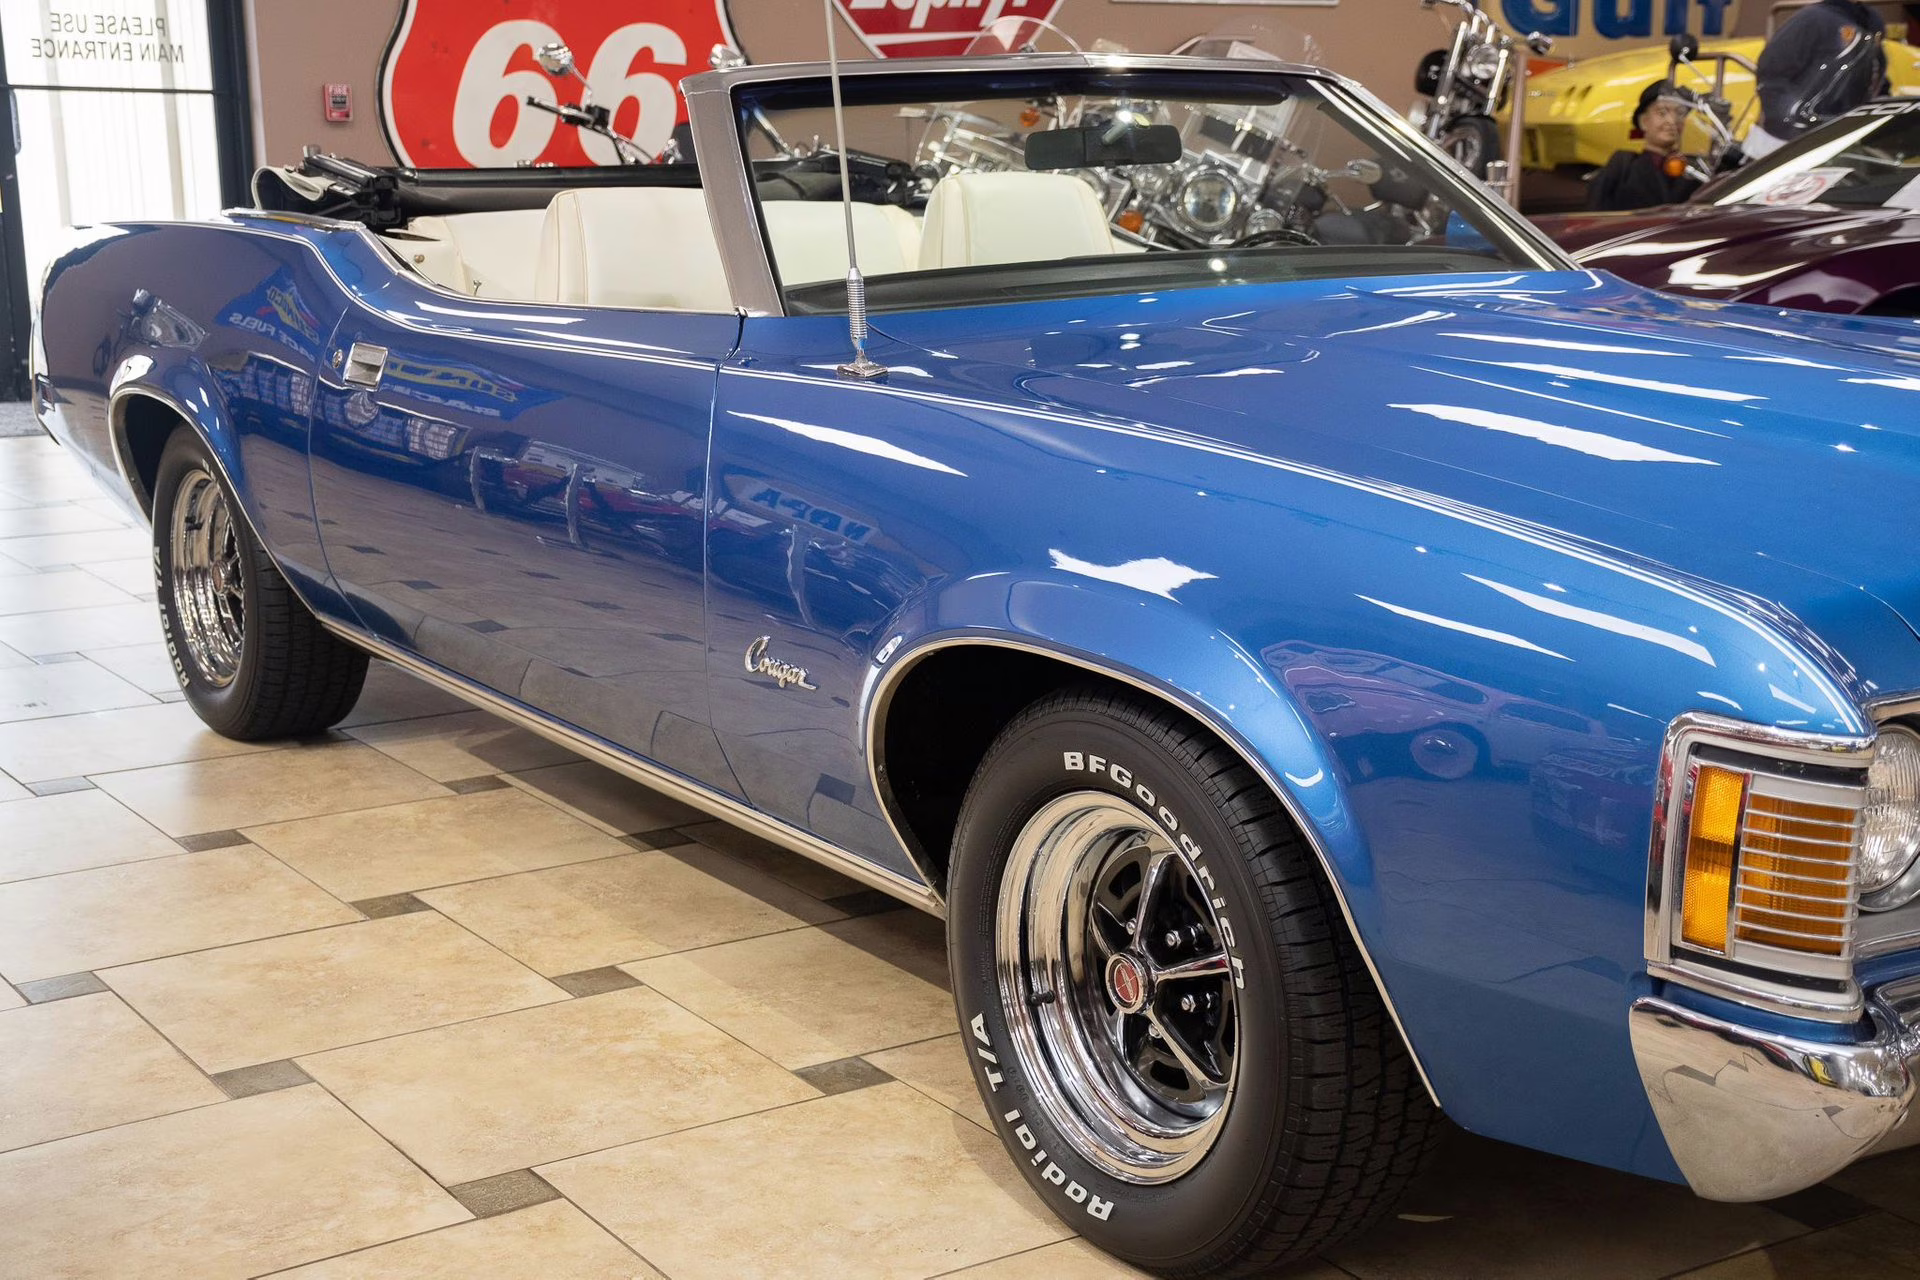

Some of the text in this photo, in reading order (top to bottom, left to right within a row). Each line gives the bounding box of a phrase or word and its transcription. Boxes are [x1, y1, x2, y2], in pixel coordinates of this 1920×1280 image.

[453, 19, 688, 168] 66
[745, 635, 817, 691] Cougar
[1063, 751, 1245, 990] BFGoodrich
[970, 1013, 1004, 1093] T/A
[1004, 1109, 1115, 1221] Radial
